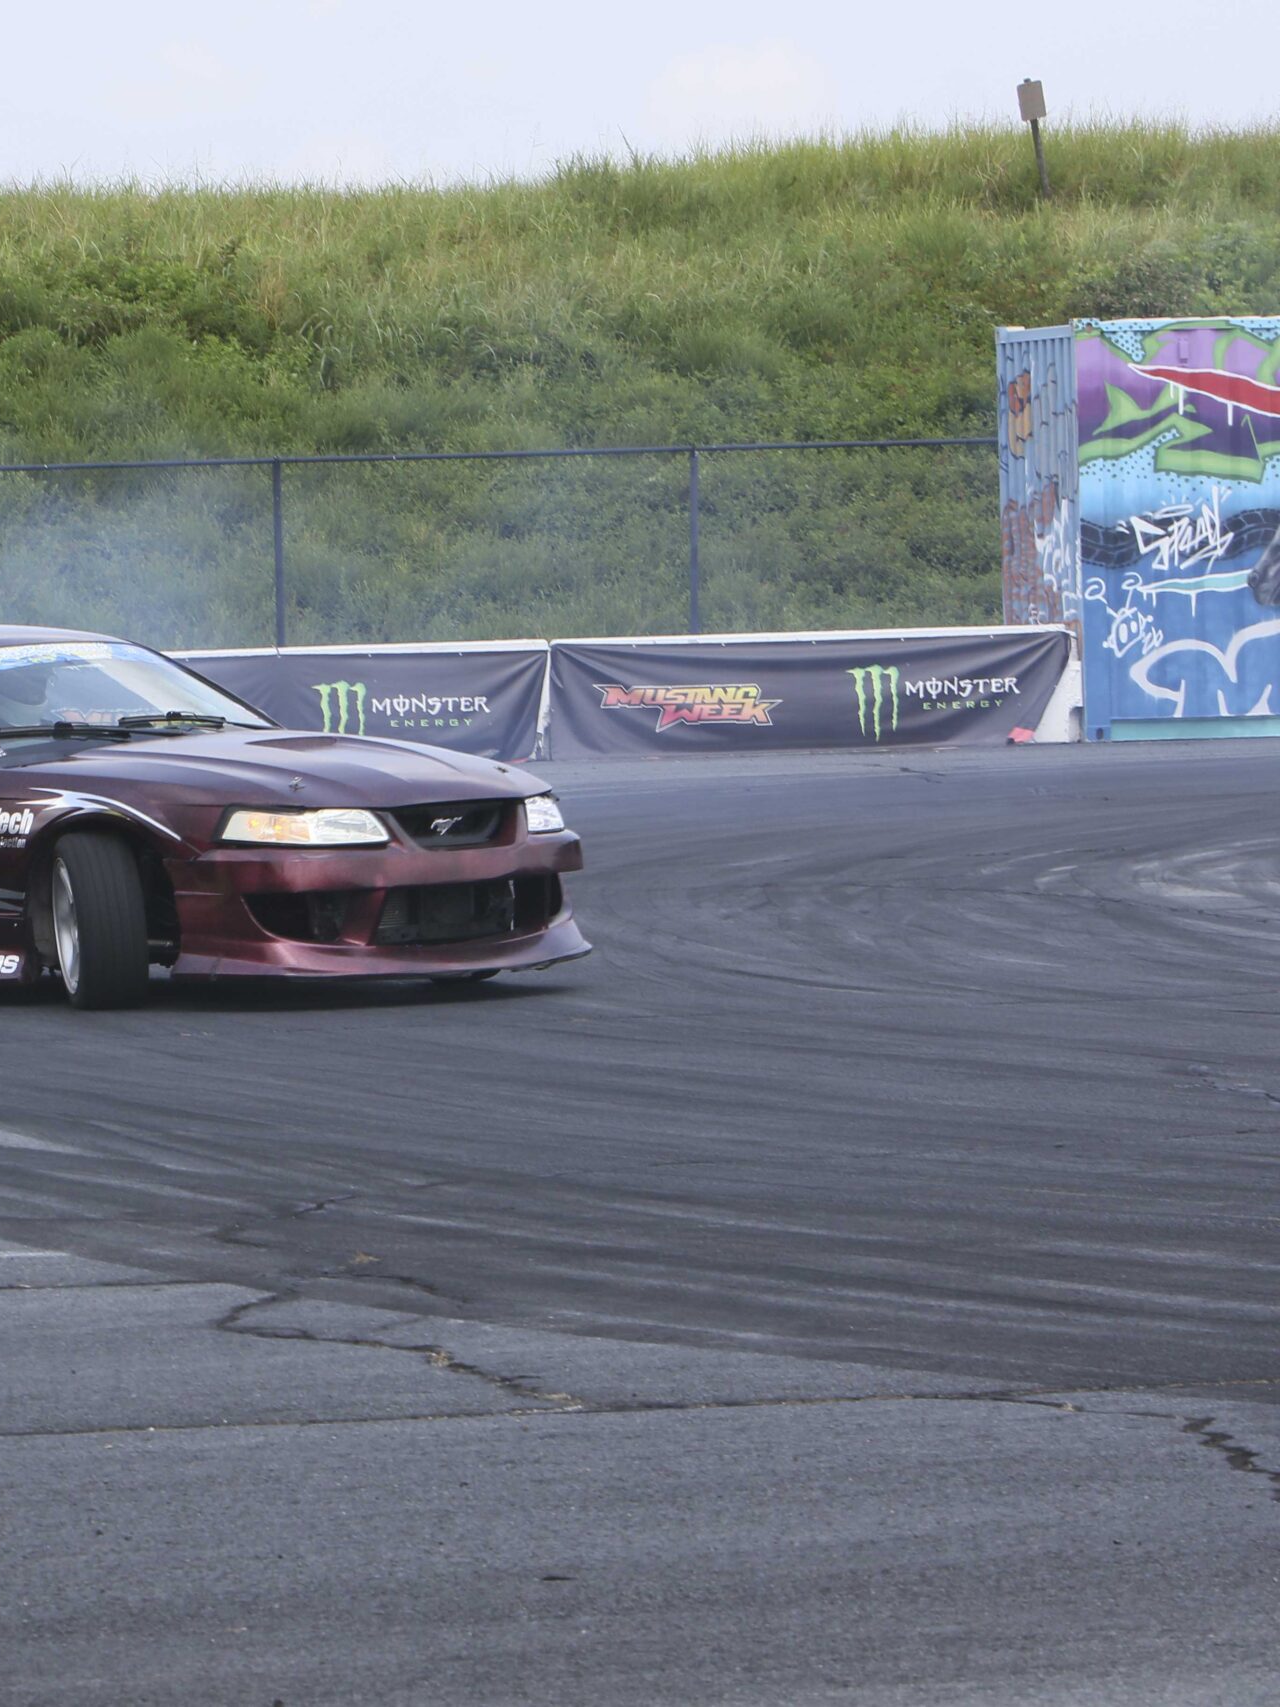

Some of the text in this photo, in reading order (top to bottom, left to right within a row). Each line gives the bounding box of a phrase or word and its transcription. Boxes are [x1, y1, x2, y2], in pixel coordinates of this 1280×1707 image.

[598, 685, 761, 708] MUSTANG
[904, 676, 1021, 699] MONSTER
[372, 693, 491, 717] MONSTER
[659, 701, 774, 732] WEEK
[922, 699, 1003, 711] ENERGY
[390, 717, 473, 729] ENERGY
